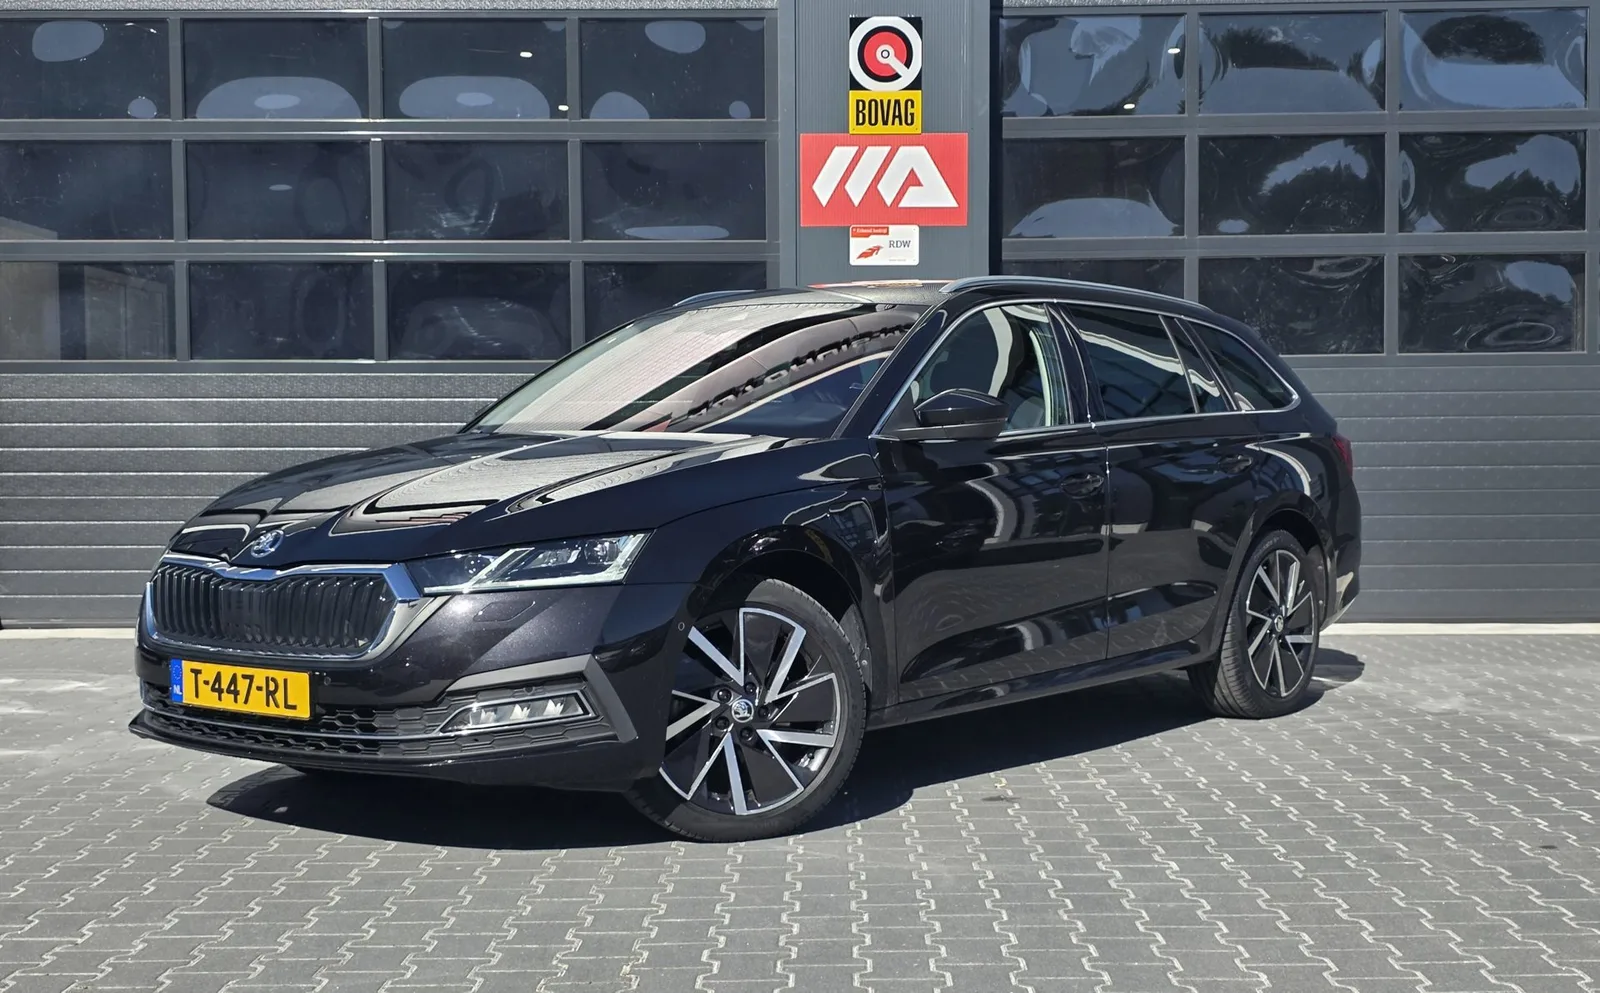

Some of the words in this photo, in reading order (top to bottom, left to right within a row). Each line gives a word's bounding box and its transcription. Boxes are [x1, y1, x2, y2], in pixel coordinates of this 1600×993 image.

[855, 98, 915, 126] BOVAG
[888, 240, 911, 248] RDW
[173, 684, 183, 695] NL
[189, 667, 298, 711] T-447-RL
